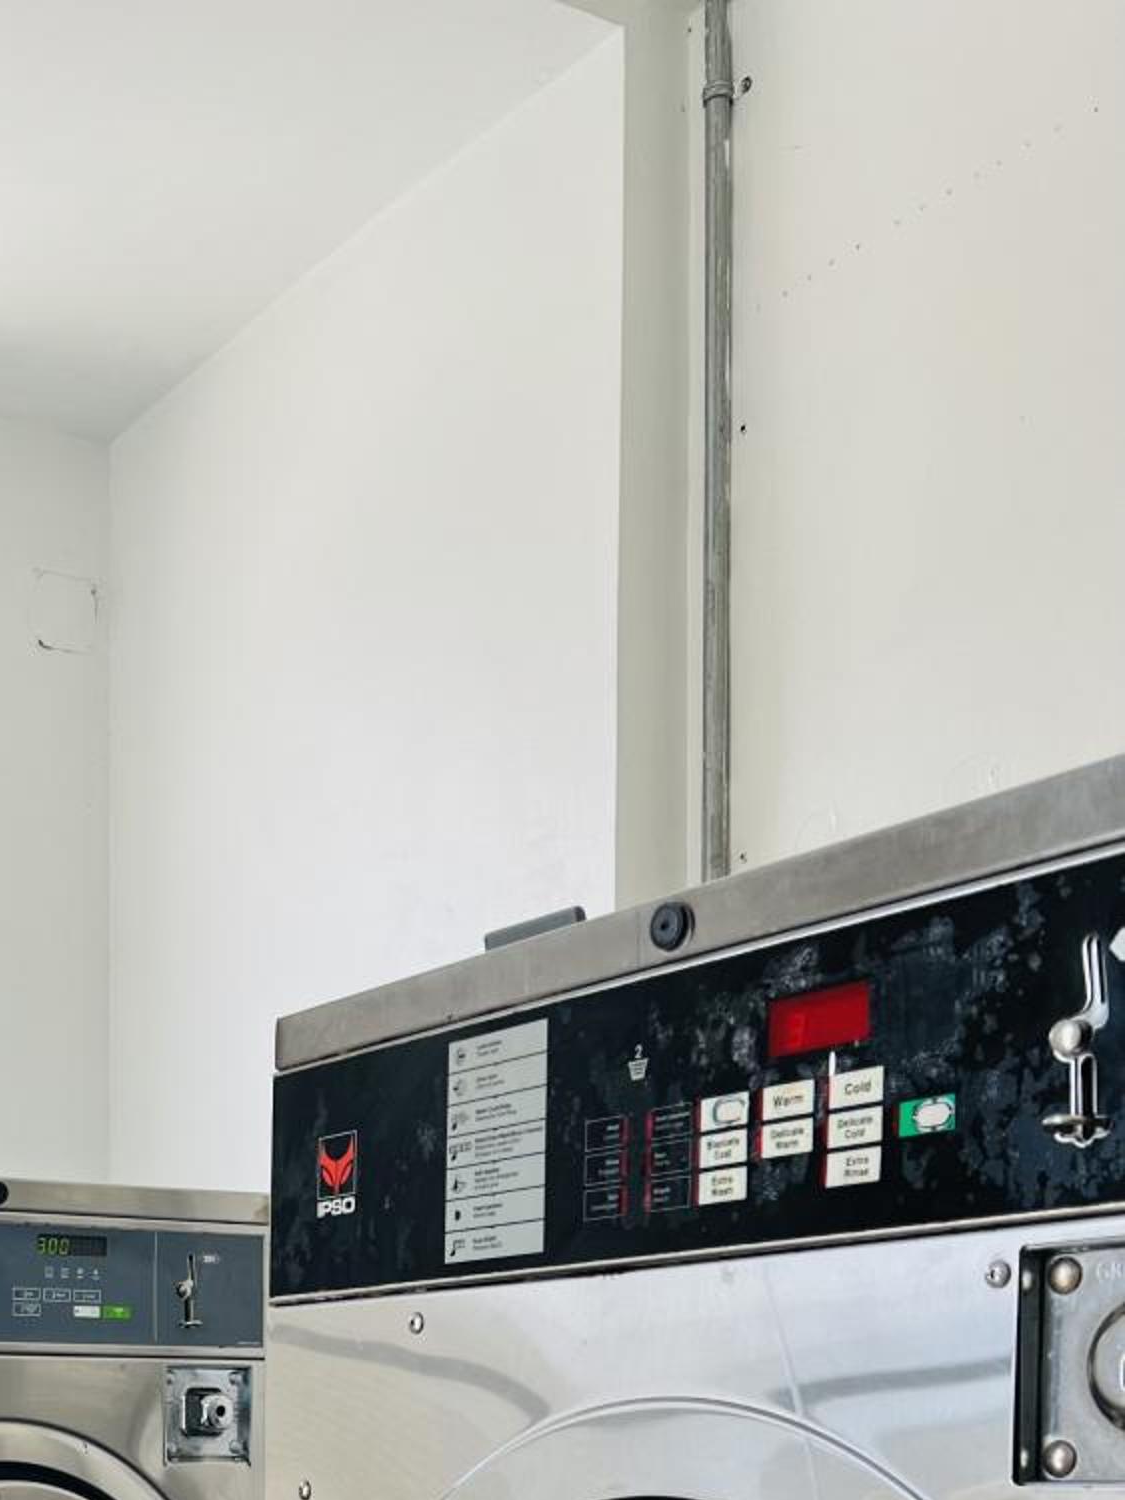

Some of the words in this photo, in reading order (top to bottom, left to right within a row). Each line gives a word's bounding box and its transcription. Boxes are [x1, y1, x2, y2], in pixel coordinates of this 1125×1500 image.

[634, 1043, 644, 1059] 2
[843, 1080, 873, 1096] Cold
[772, 1093, 804, 1107] Warm
[316, 1196, 355, 1218] IPSO
